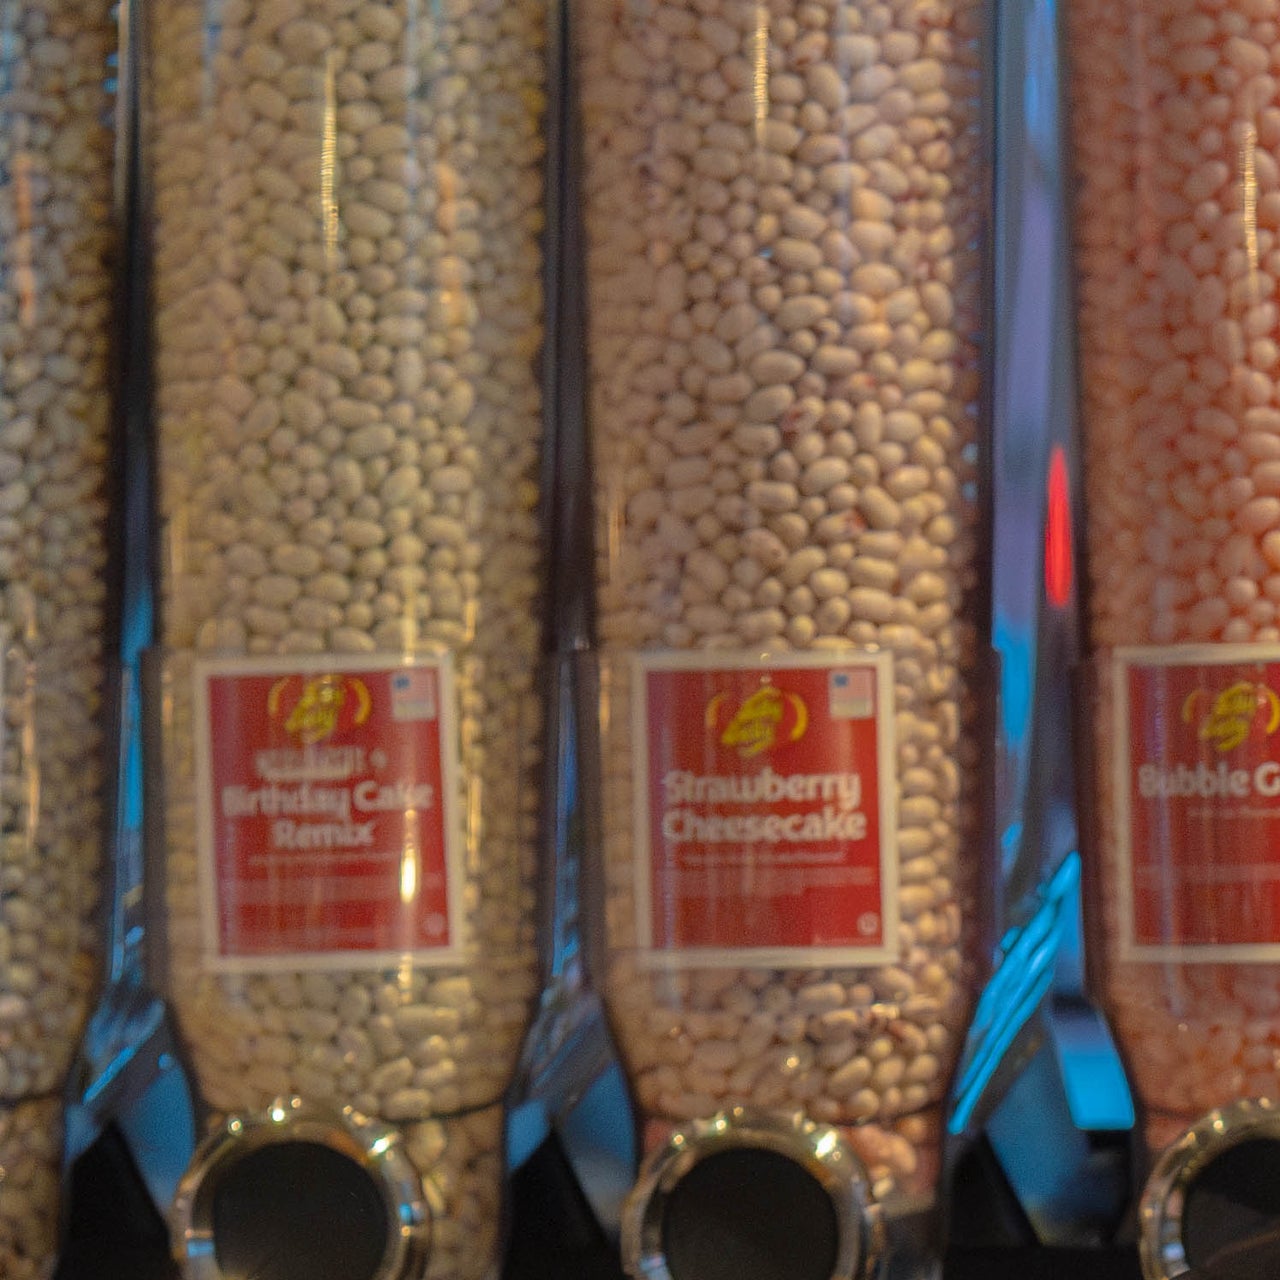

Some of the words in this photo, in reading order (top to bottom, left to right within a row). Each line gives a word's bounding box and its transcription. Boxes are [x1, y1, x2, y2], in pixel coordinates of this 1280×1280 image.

[662, 766, 861, 810] Strawberry
[1137, 761, 1249, 797] Bubble
[662, 805, 868, 843] Cheesecake
